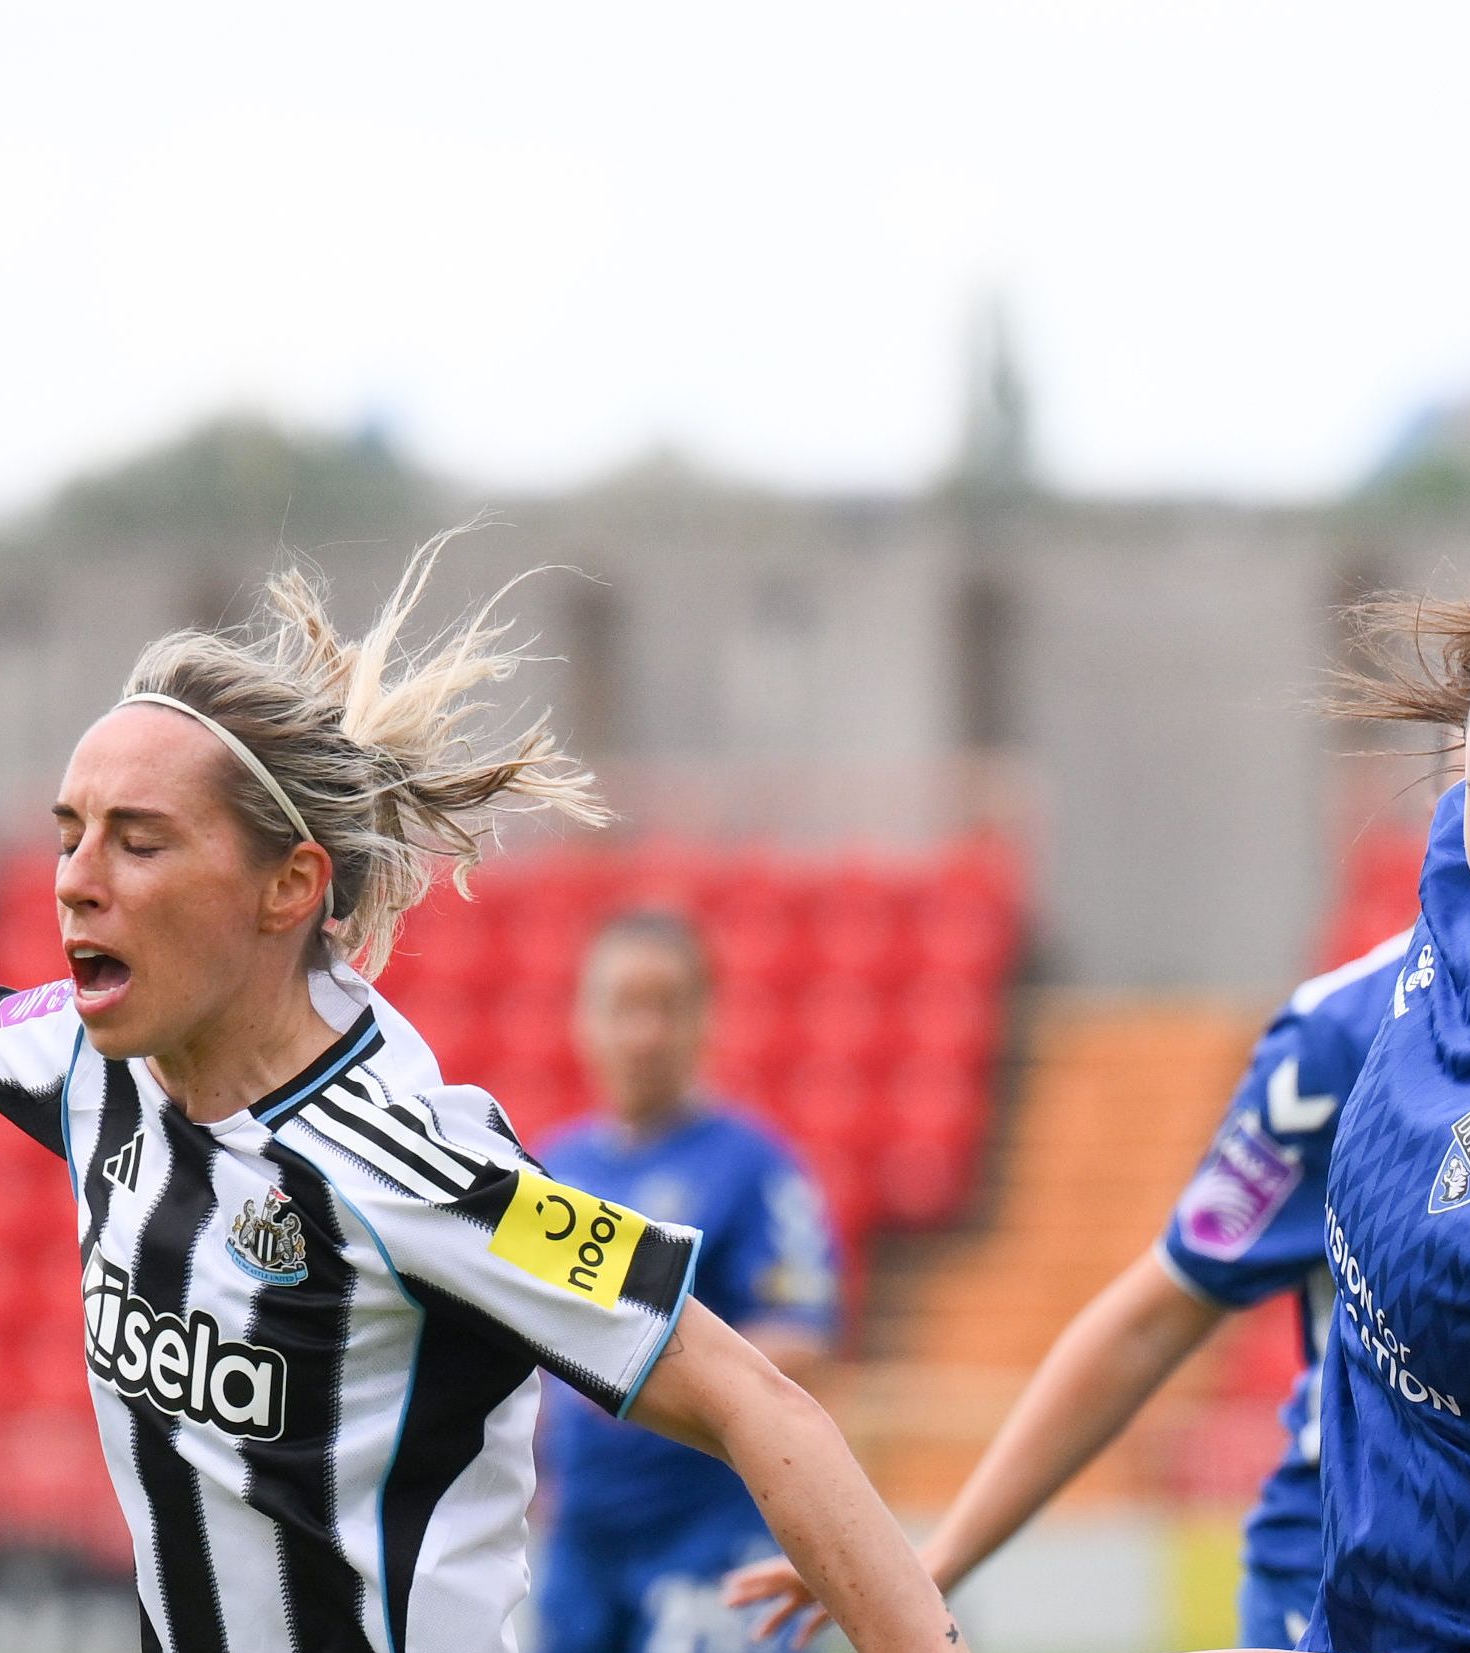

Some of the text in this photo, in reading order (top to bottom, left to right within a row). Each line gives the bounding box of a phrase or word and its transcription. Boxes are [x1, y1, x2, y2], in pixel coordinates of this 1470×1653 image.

[1325, 1194, 1410, 1363] VISION for
[117, 1311, 273, 1427] sela
